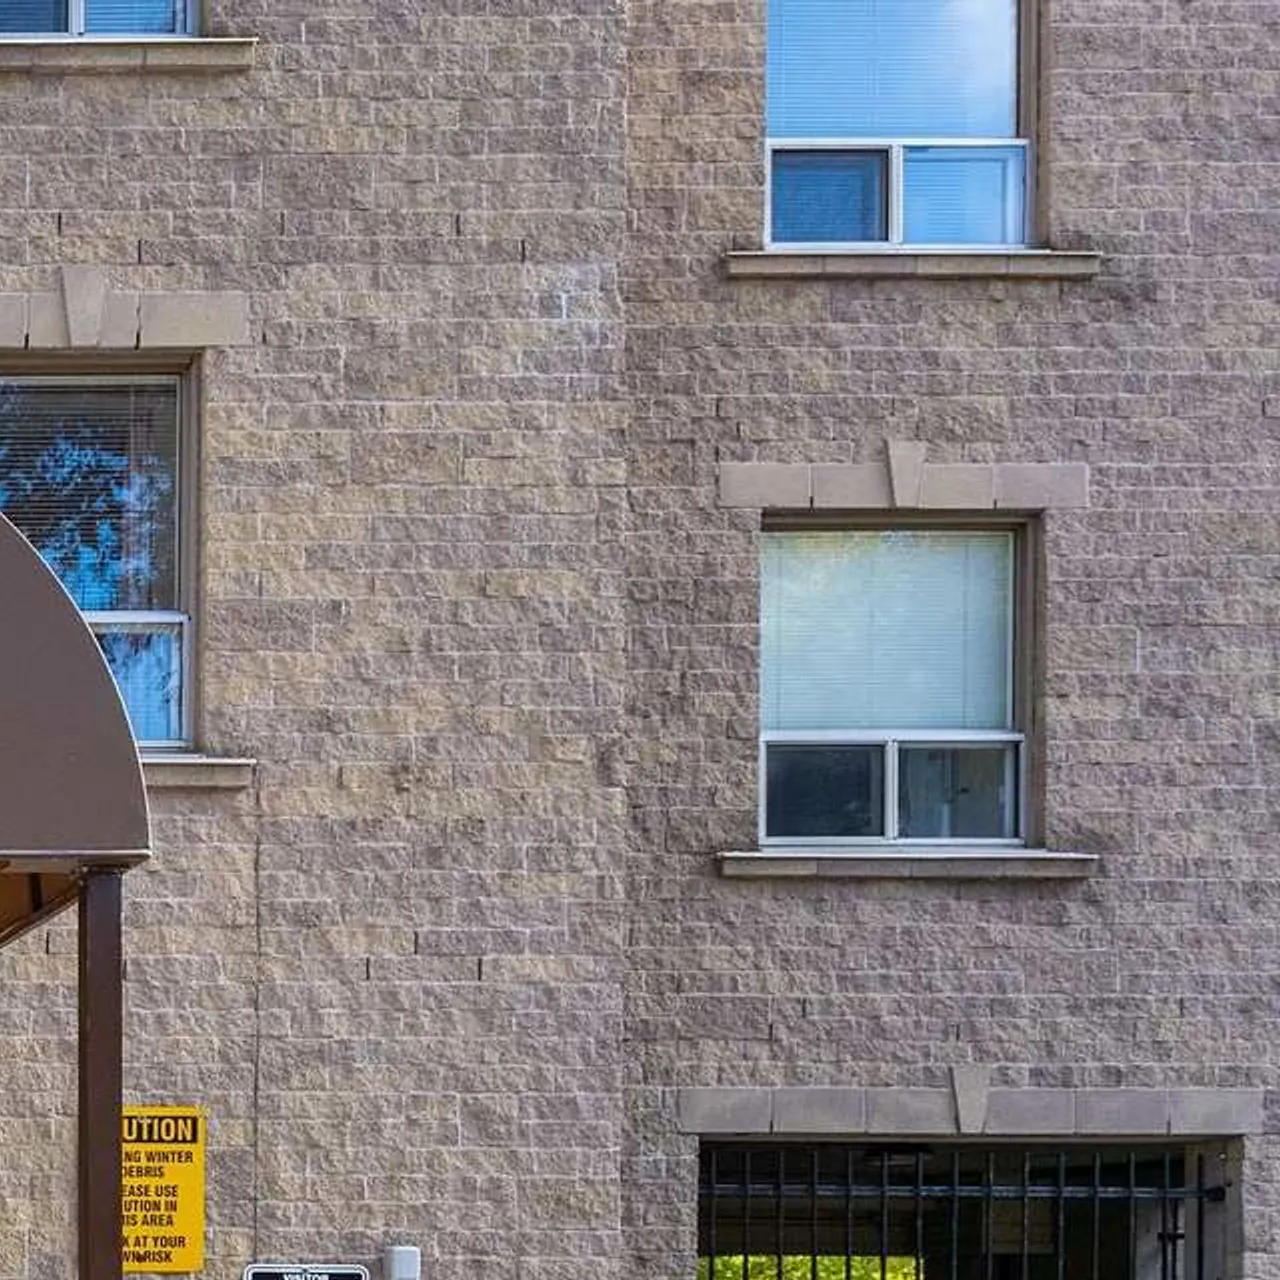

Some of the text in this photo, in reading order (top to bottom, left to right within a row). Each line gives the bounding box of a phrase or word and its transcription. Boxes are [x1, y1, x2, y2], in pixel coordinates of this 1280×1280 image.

[123, 1118, 193, 1141] UTION
[124, 1151, 193, 1163] NG WINTER
[121, 1185, 178, 1197] EASE USE
[124, 1200, 178, 1212] UTION IN
[141, 1215, 174, 1226] AREA
[134, 1236, 148, 1248] AT
[152, 1236, 186, 1248] YOUR
[144, 1251, 173, 1263] RISK
